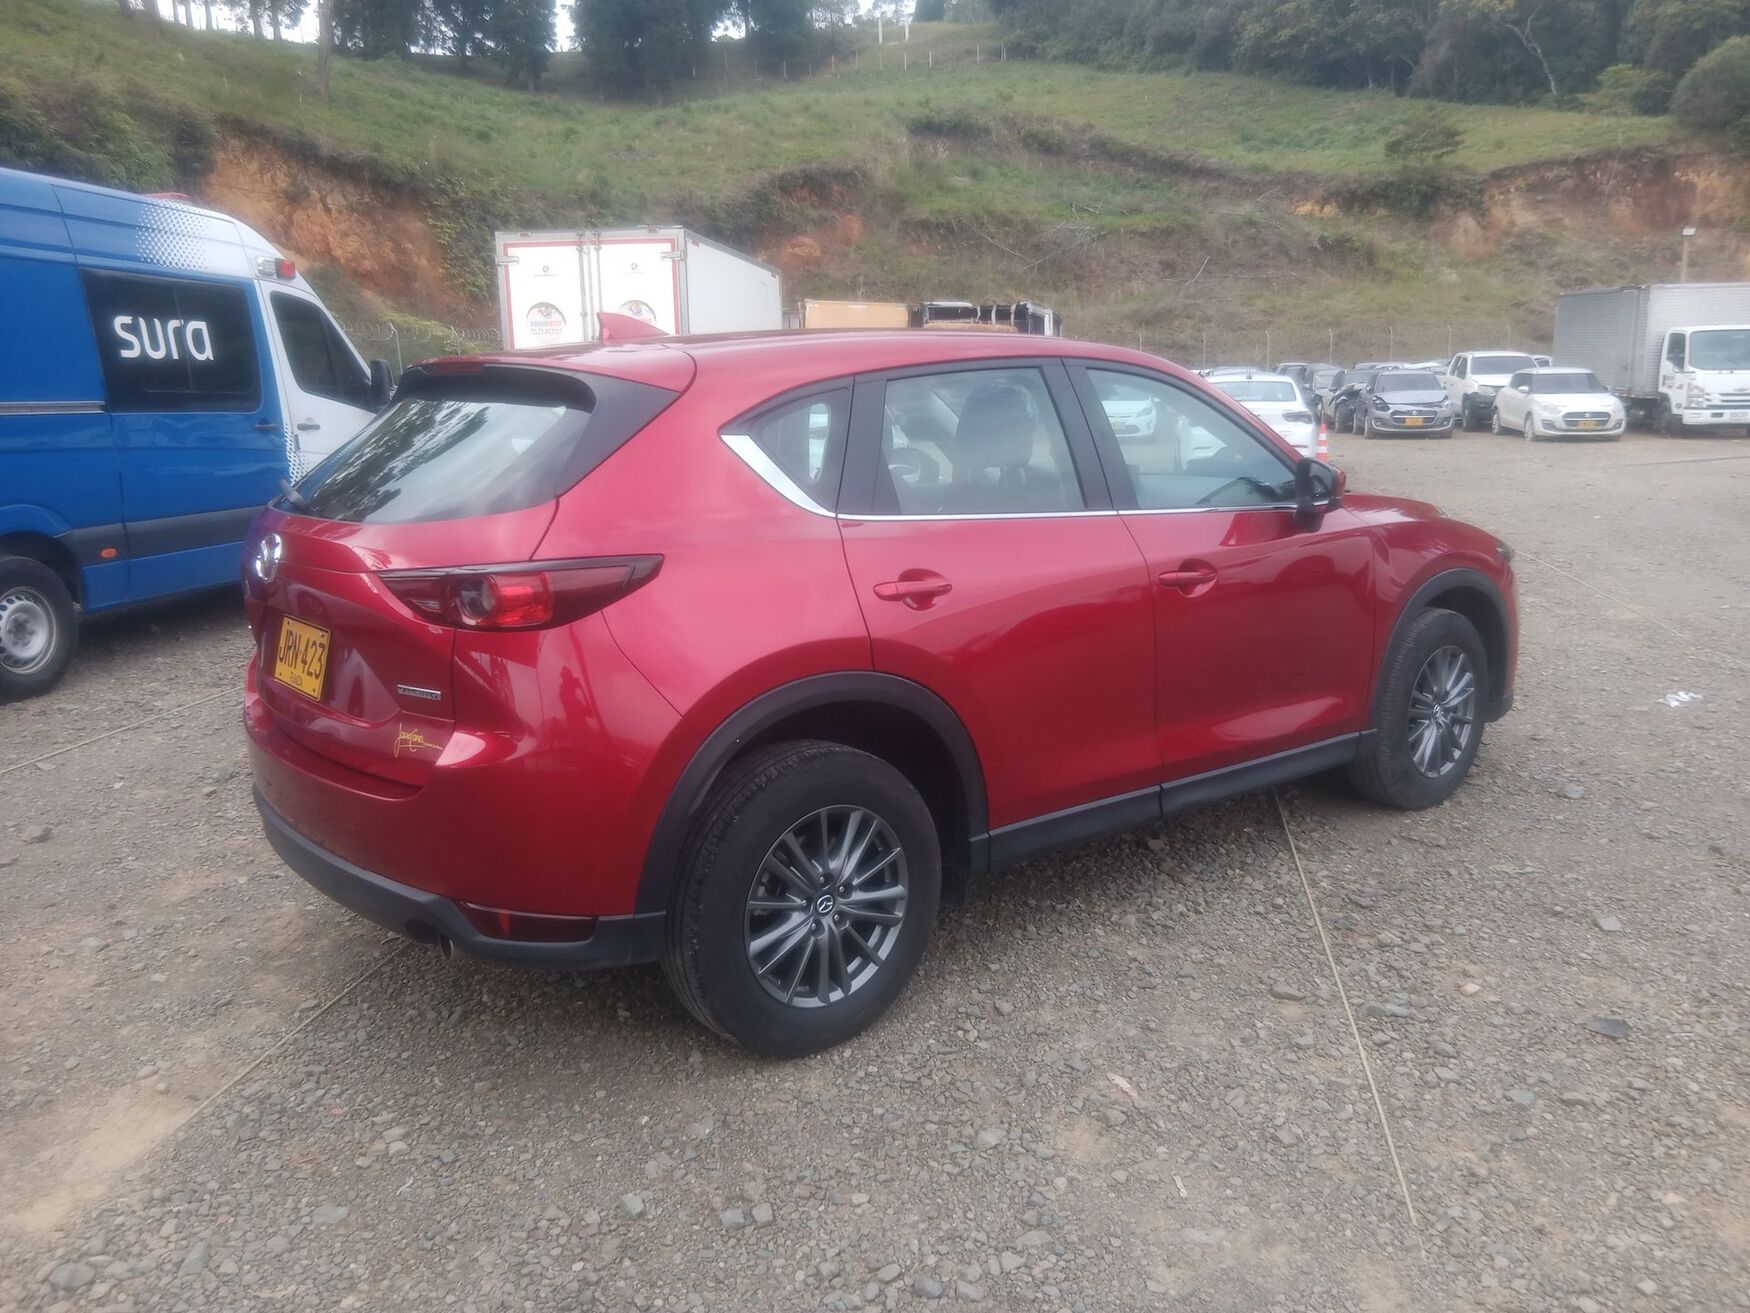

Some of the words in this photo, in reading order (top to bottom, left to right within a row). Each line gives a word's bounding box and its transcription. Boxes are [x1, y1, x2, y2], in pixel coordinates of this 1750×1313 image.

[113, 315, 214, 361] sura
[278, 629, 302, 670] JRN
[301, 637, 325, 679] 423
